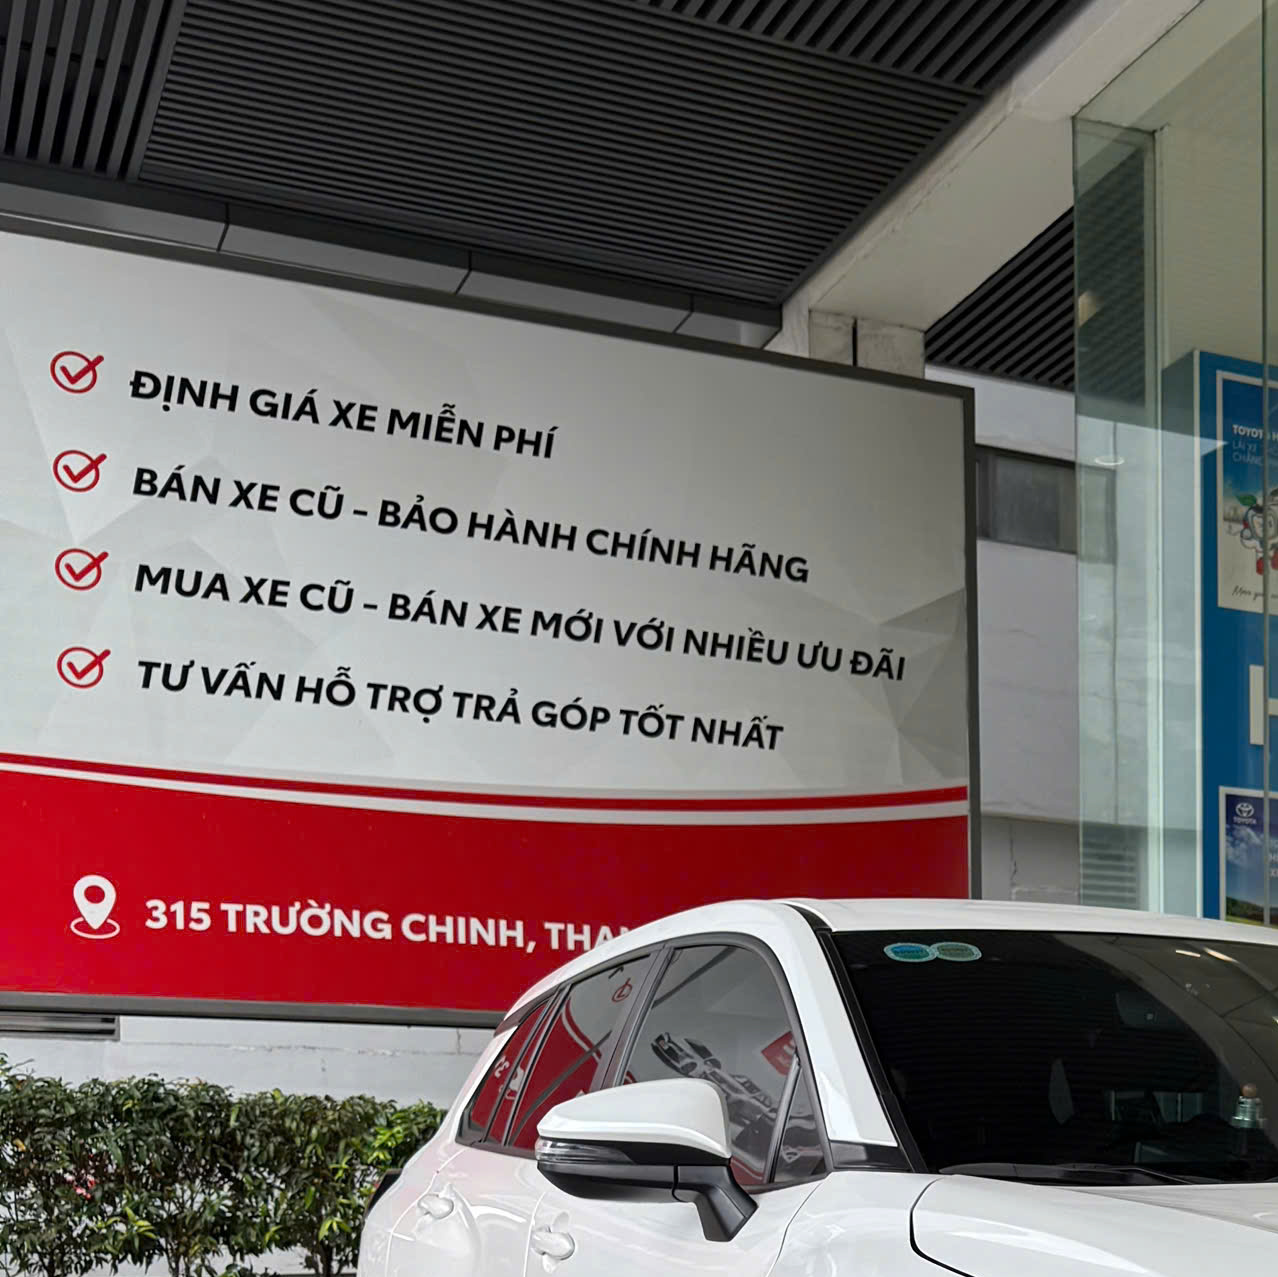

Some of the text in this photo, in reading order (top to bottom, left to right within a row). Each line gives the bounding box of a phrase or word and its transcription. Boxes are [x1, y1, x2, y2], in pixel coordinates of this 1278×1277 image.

[129, 370, 559, 459] ĐỊNH GIÁ XE MIỄN PHÍ
[132, 464, 221, 505] BÁN
[228, 479, 281, 513] XE
[289, 485, 345, 520] CŨ
[378, 494, 459, 535] BẢO
[467, 508, 578, 552] HÀNH
[585, 528, 702, 569] CHÍNH
[708, 542, 809, 584] HÃNG
[134, 564, 230, 602] MUA
[239, 575, 291, 608] XE
[299, 579, 354, 614] CŨ
[388, 589, 469, 628] BÁN
[475, 603, 523, 634] XE
[530, 608, 604, 644] MỚI
[613, 617, 675, 653] VỚI
[682, 626, 790, 666] NHIỀU
[796, 640, 844, 673] ƯU
[849, 647, 906, 682] ĐÃI
[138, 659, 785, 751] TƯ VẤN HỖ TRỢ TRẢ GÓP TỐT NHẤT
[145, 899, 630, 953] 315 TRƯỜNG CHINH, THA
